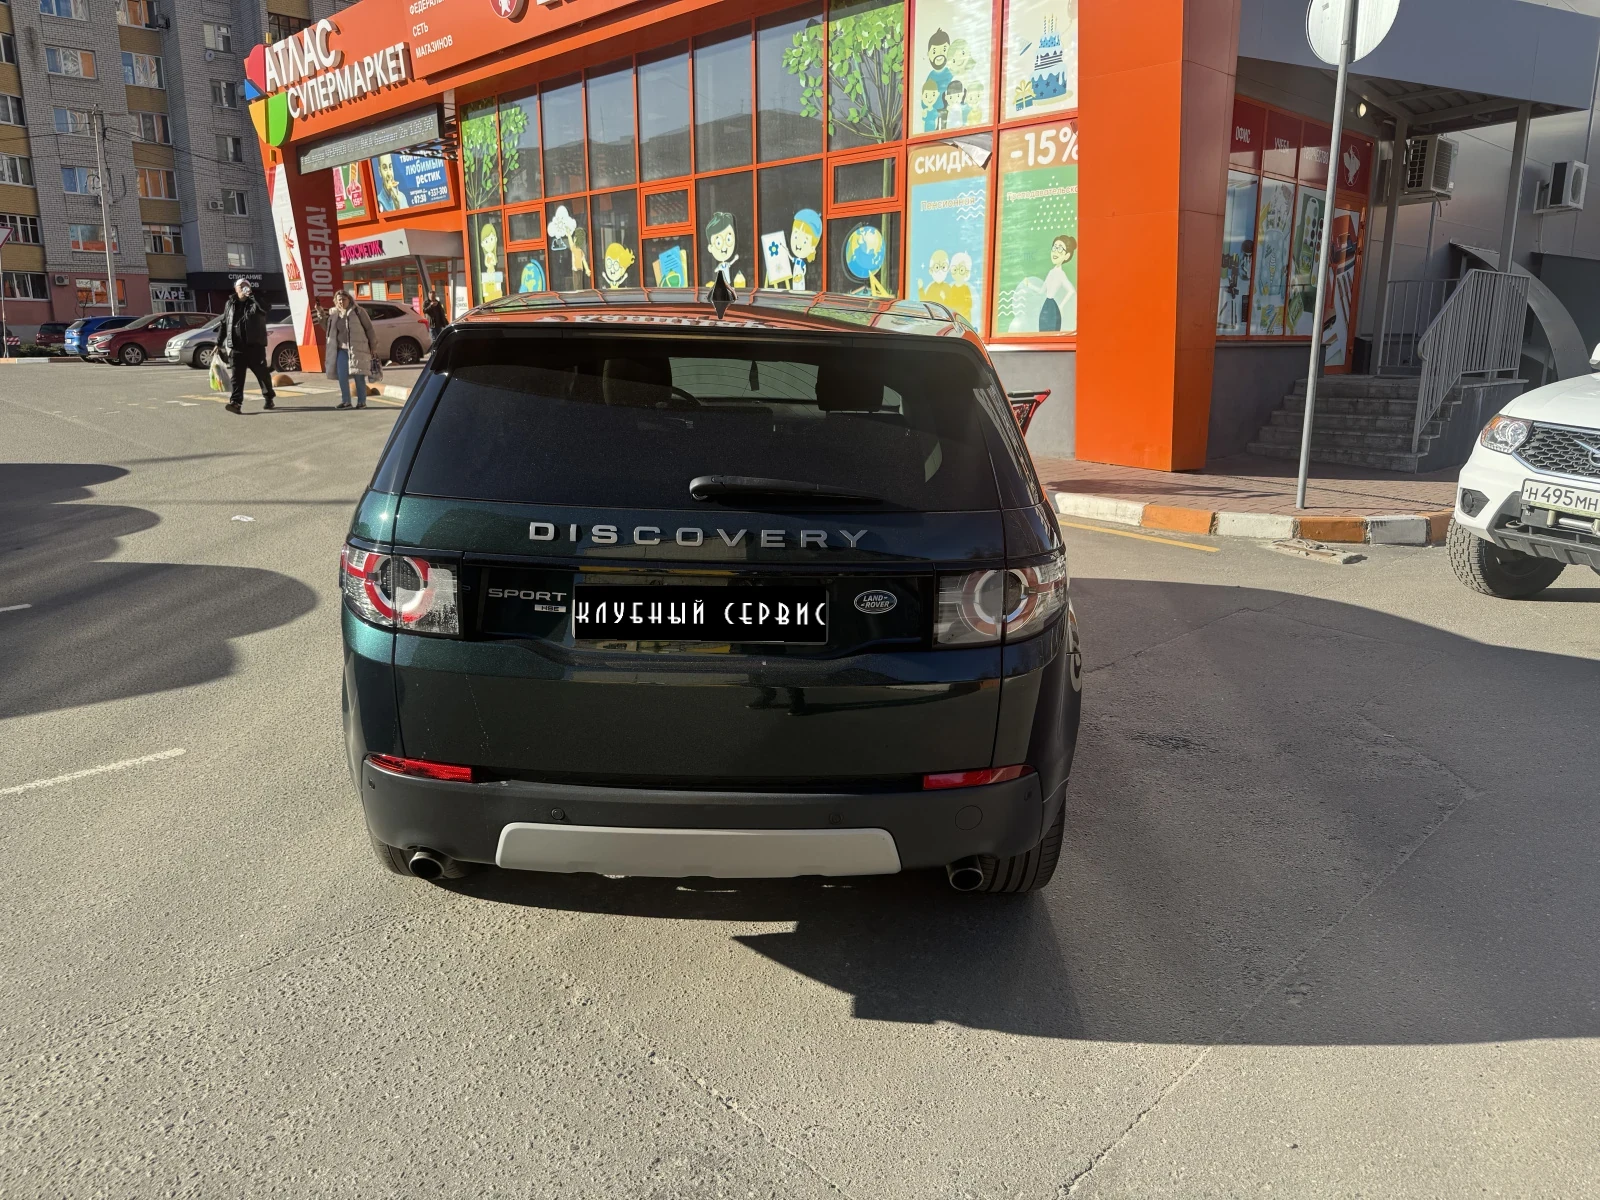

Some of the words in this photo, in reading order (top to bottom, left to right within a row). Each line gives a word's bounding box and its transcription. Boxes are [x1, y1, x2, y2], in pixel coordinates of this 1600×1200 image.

[412, 22, 429, 37] СЕТЬ
[265, 18, 339, 92] АТЛАС
[415, 35, 453, 59] МАГАЗИНОВ
[287, 42, 408, 119] СУПЕРМАРКЕТ
[1235, 125, 1251, 144] ОФИС
[1010, 127, 1078, 167] -15%
[920, 196, 976, 212] Пенсионная
[305, 206, 334, 297] ПОБЕДА!
[157, 290, 186, 300] VAPE
[528, 521, 869, 549] DISCOVERY
[488, 588, 567, 602] SPORT
[863, 594, 884, 602] LAND
